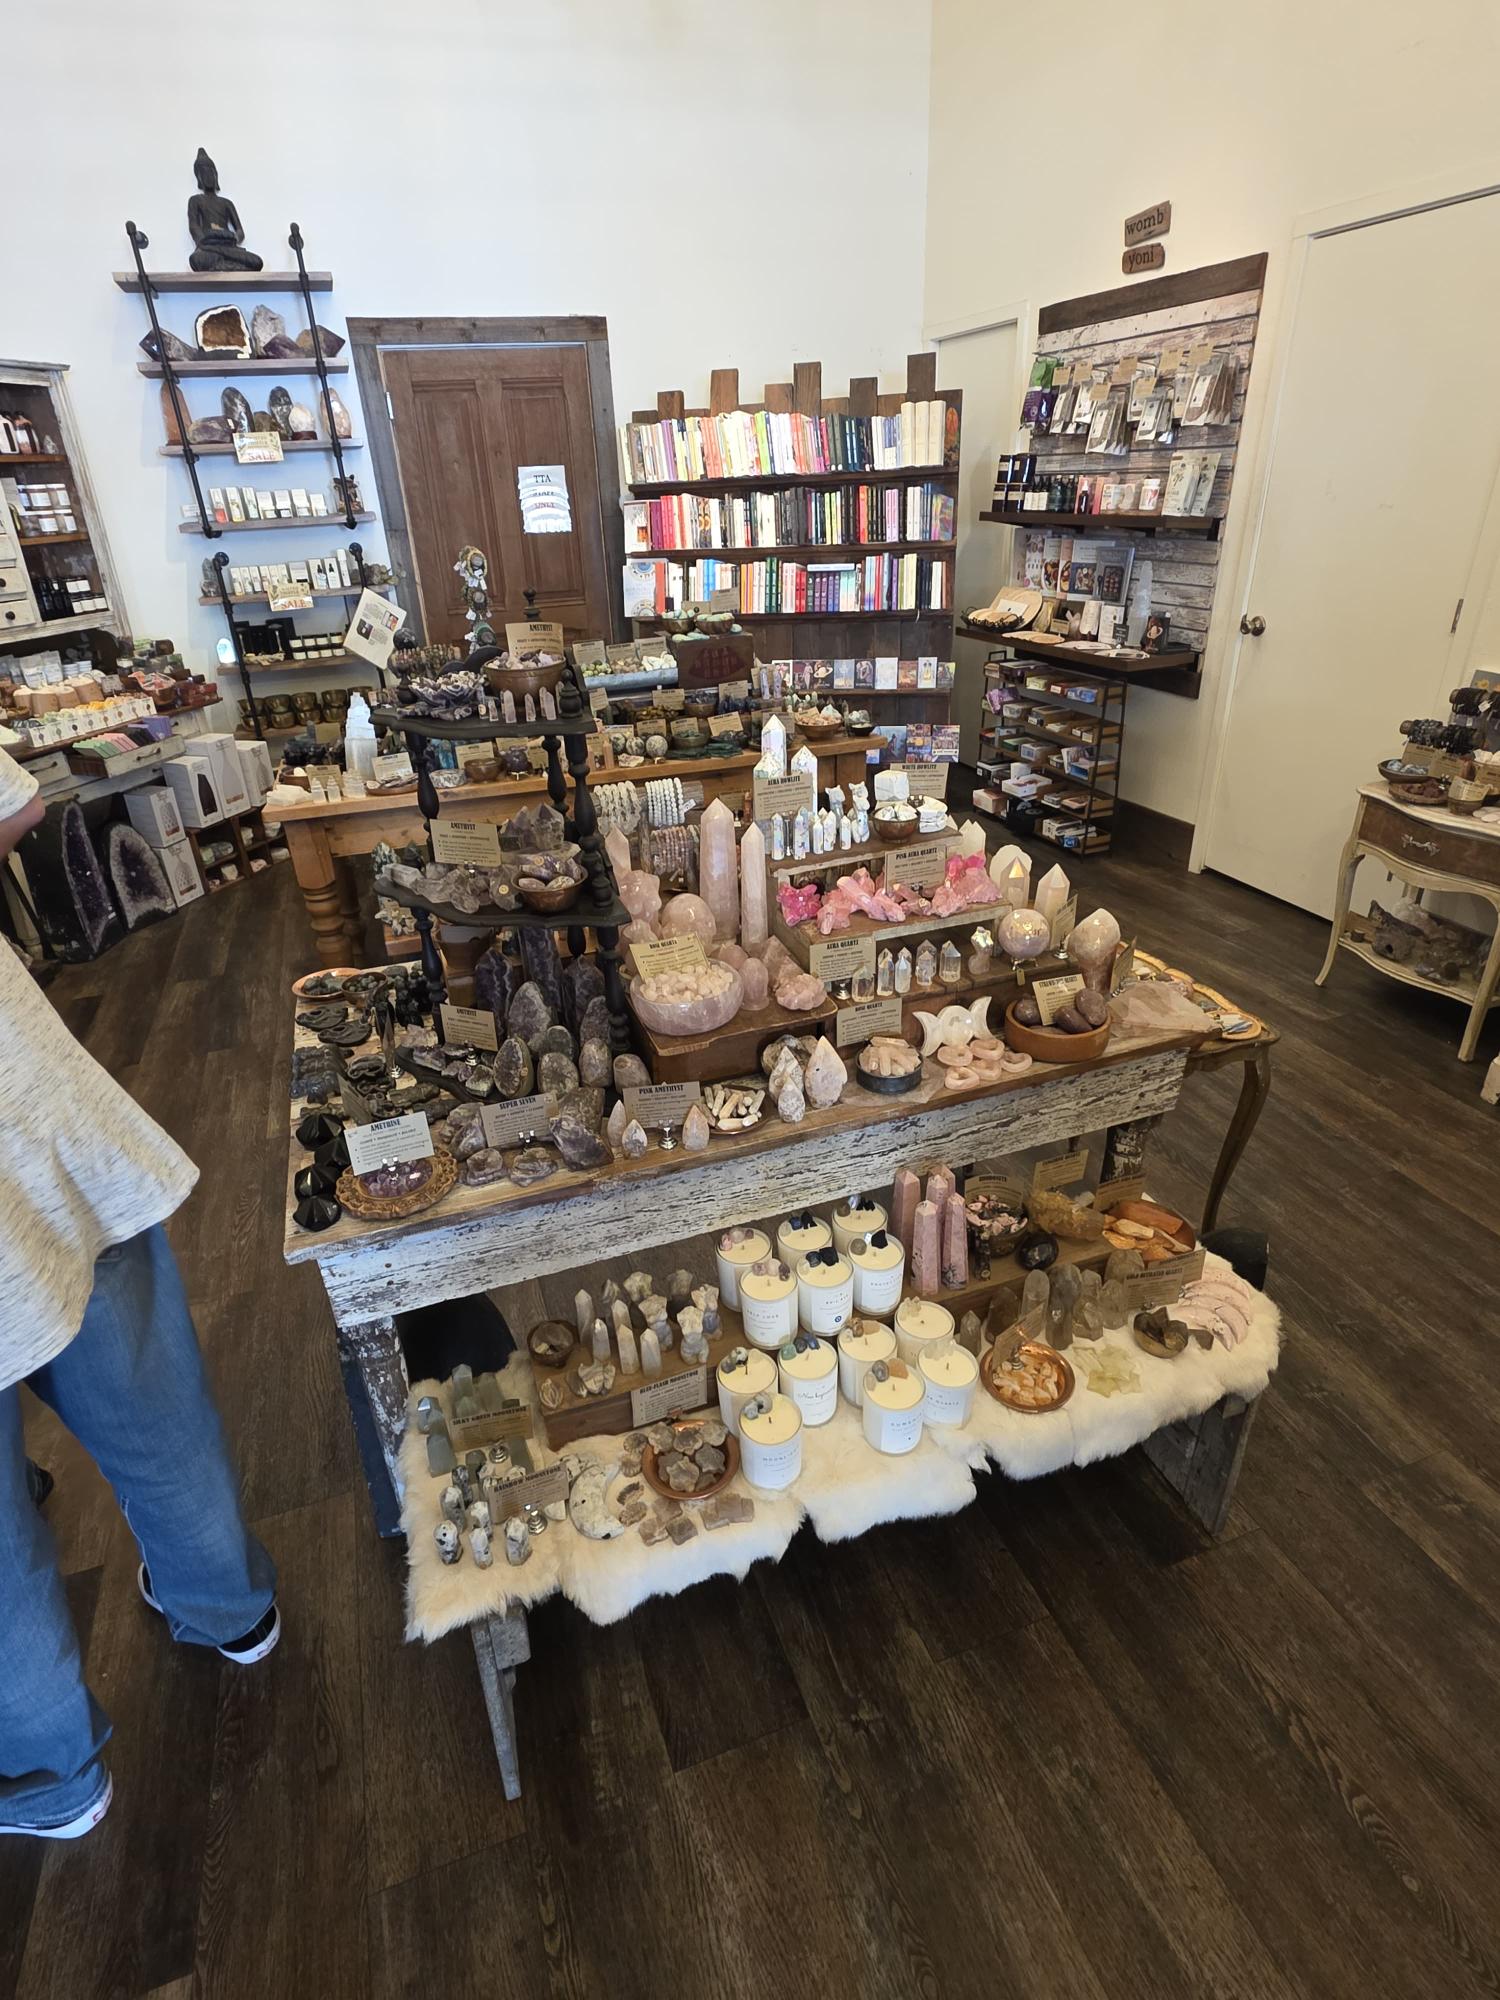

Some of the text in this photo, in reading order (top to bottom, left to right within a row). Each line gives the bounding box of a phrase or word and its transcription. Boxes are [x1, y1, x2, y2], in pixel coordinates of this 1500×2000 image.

[1126, 208, 1164, 235] womb
[1128, 245, 1154, 272] yoni
[908, 850, 920, 858] AURA
[920, 847, 938, 857] QUARTZ
[826, 939, 859, 950] AURA QUARTZ
[639, 1084, 684, 1095] PINK AMETHYST
[499, 1096, 537, 1110] SUPER SEVEN
[494, 1478, 523, 1493] RAINBOW
[524, 1465, 561, 1481] MOONSTONE
